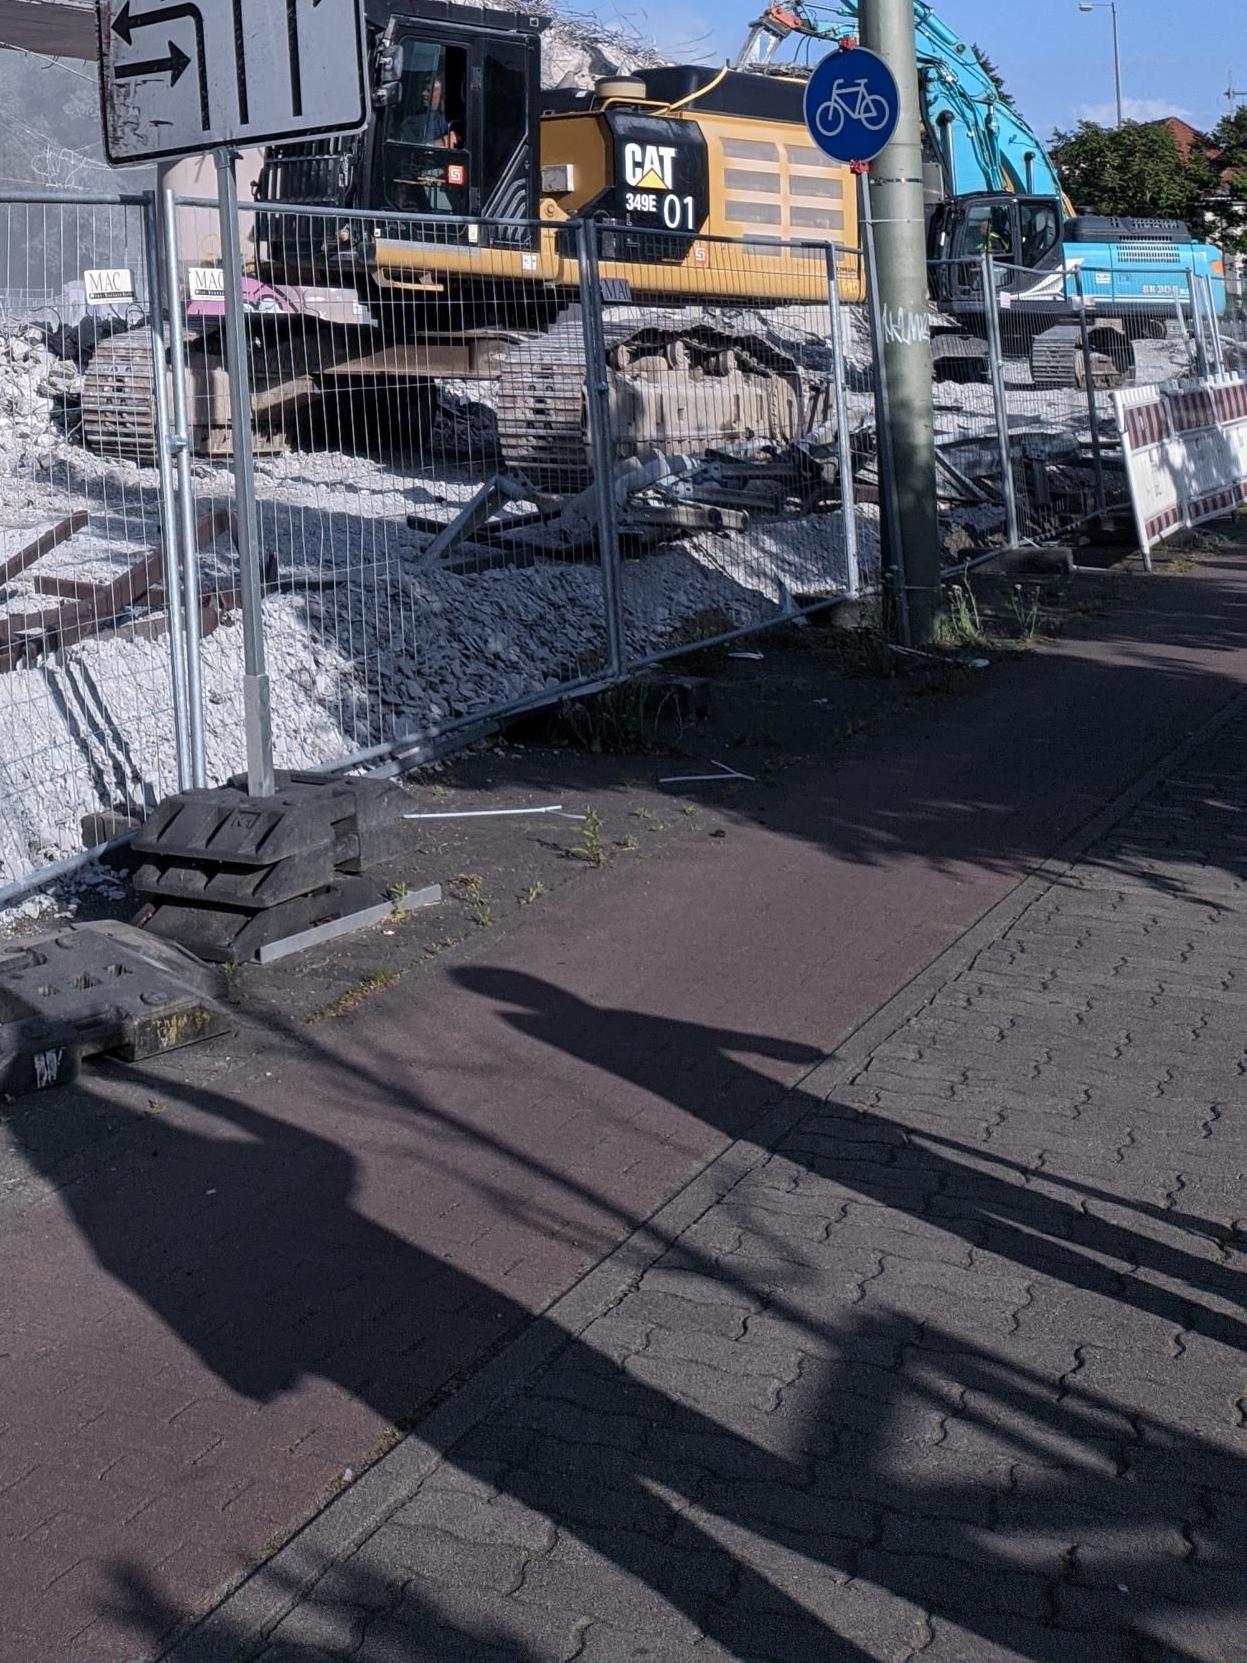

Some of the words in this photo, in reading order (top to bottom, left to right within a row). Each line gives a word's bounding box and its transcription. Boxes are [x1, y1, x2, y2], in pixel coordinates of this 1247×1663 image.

[625, 143, 677, 190] CAT
[625, 193, 658, 212] 349E
[663, 194, 694, 230] 01
[89, 271, 122, 291] MAC
